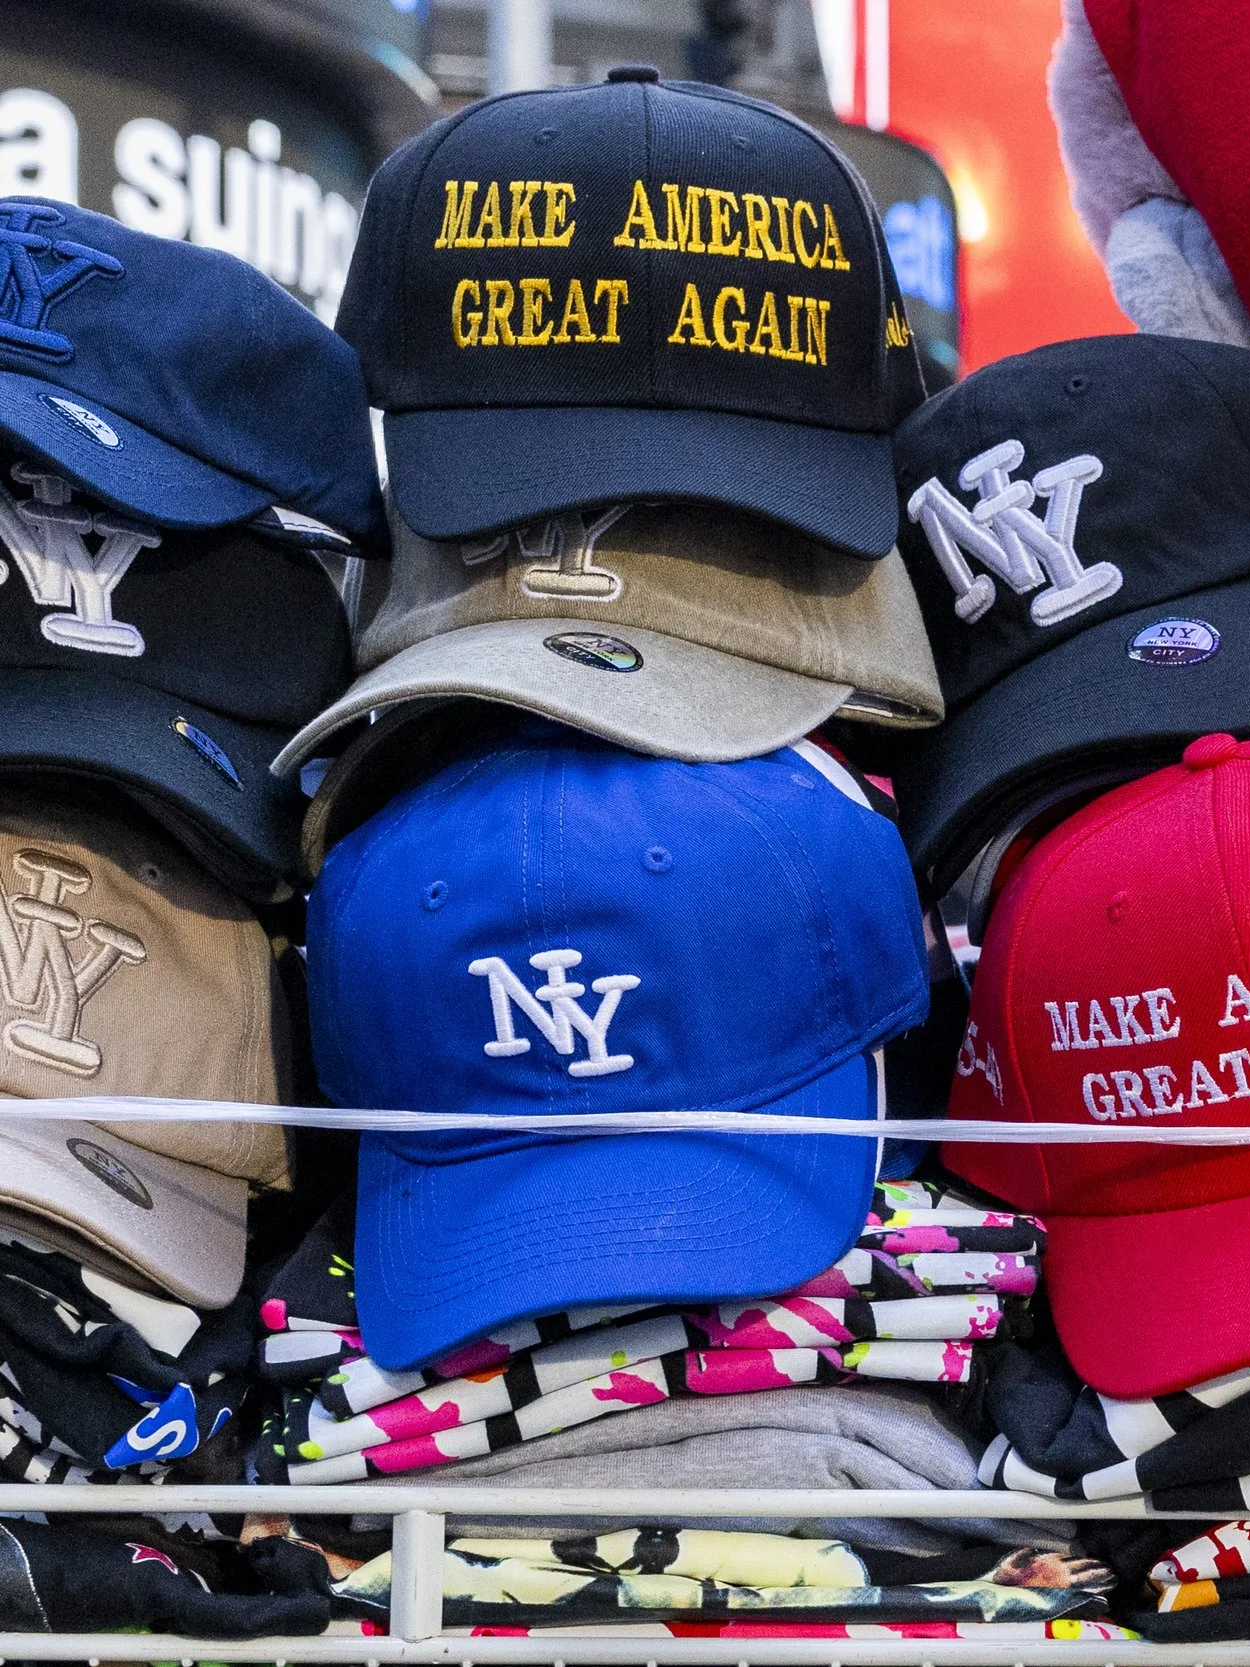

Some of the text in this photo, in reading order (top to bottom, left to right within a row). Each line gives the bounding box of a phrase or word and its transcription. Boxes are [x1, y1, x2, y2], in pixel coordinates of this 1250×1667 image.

[434, 180, 576, 248] MAKE
[613, 180, 850, 271] AMERICA
[452, 279, 628, 348] GREAT
[668, 283, 830, 366] AGAIN
[907, 439, 1124, 627] NY
[1152, 649, 1186, 657] CITY
[1157, 626, 1197, 638] NY
[468, 949, 641, 1078] NY
[1044, 987, 1180, 1051] MAKE
